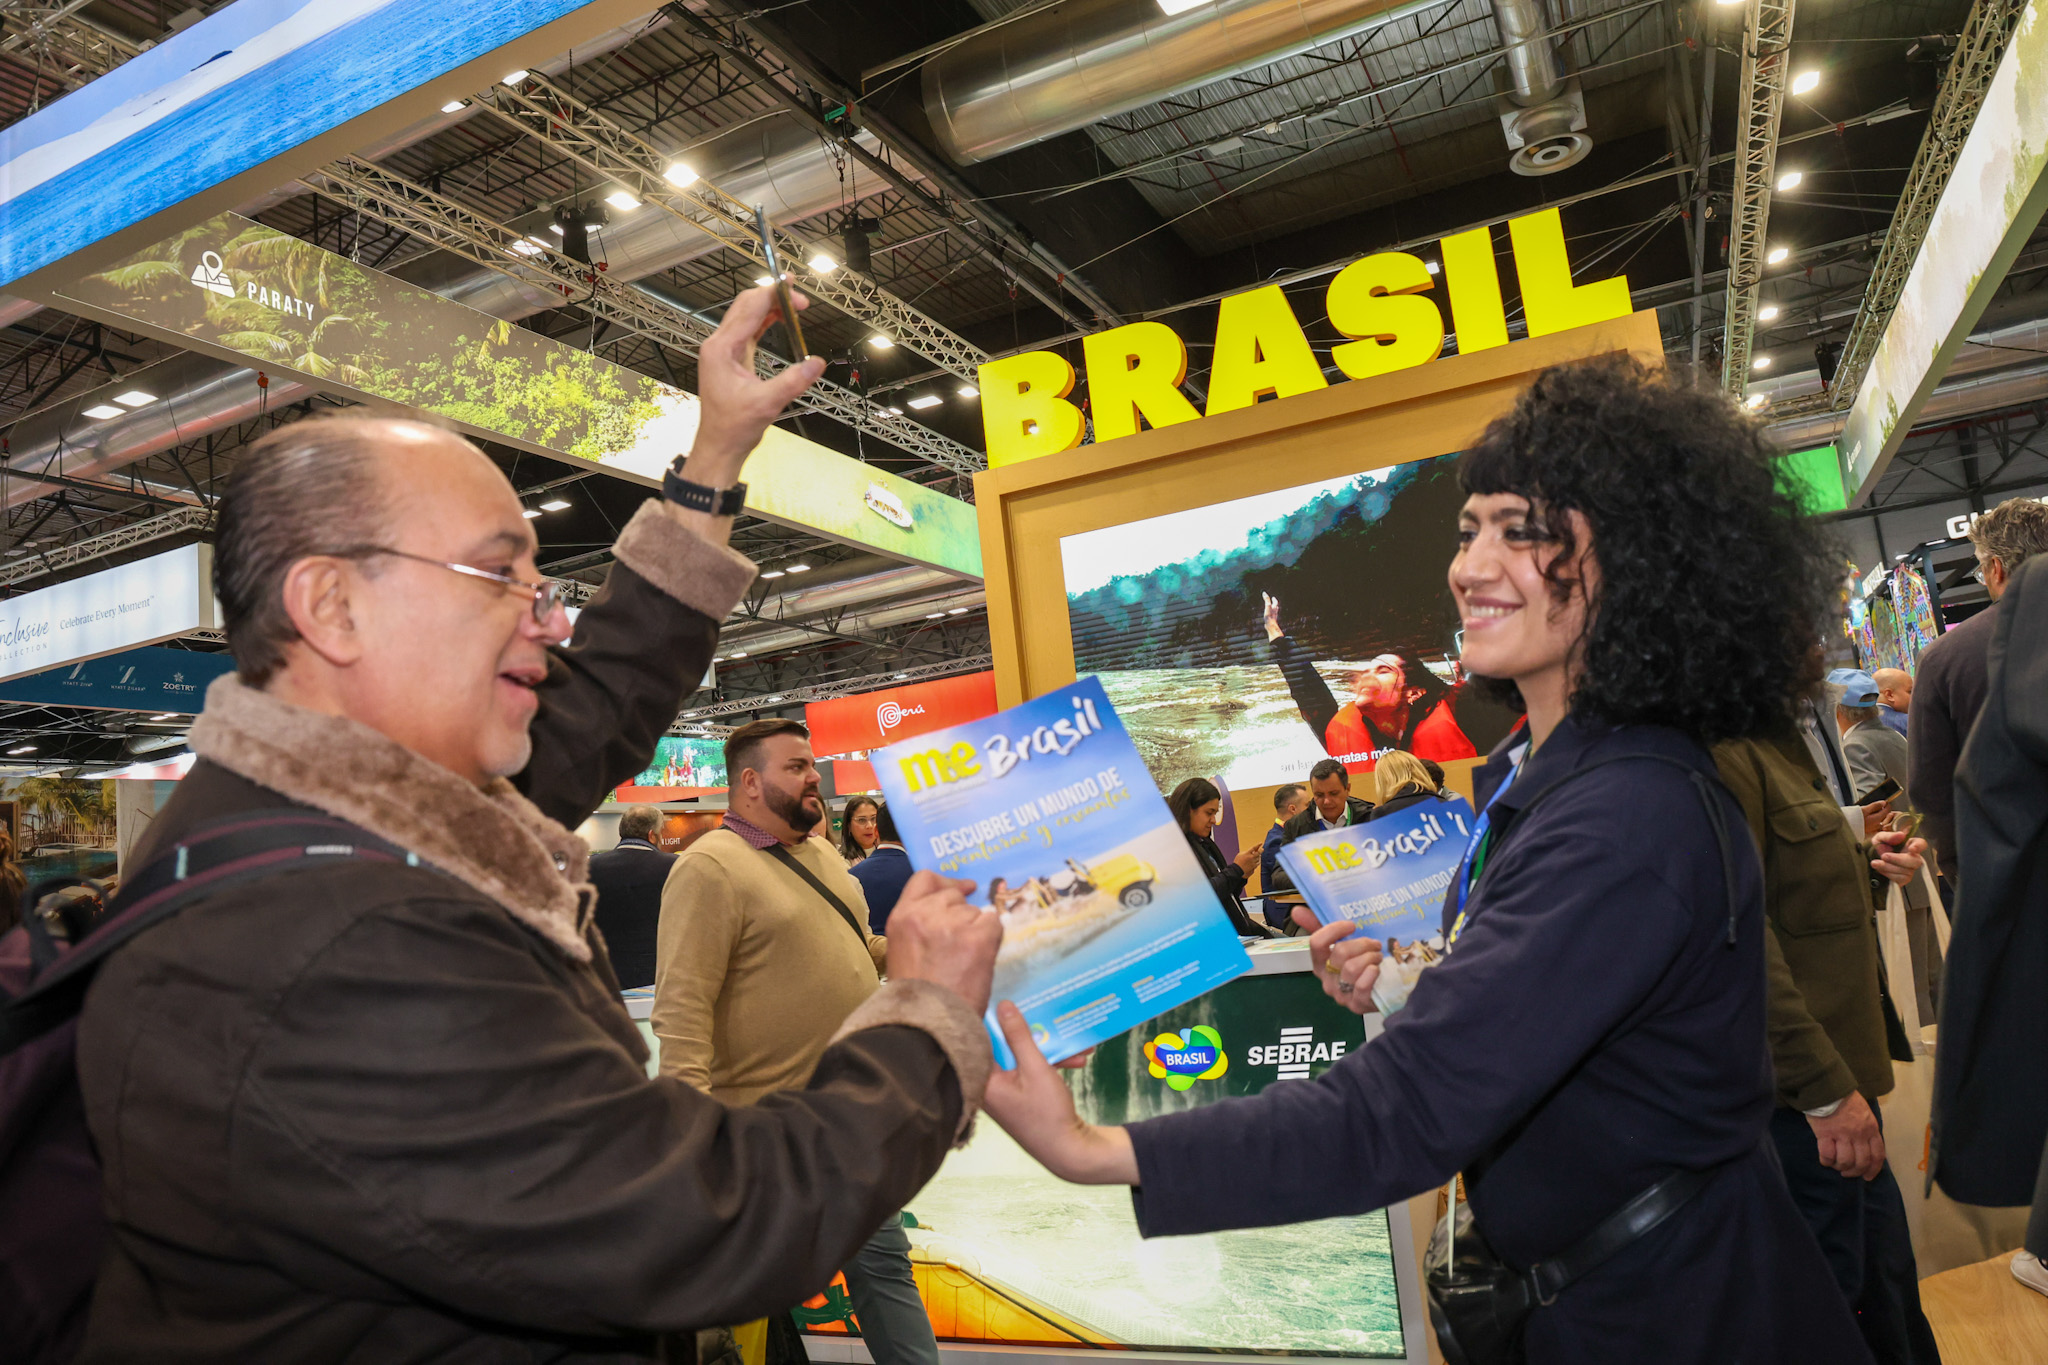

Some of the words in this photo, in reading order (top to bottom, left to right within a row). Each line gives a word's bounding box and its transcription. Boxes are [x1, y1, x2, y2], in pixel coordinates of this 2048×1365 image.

[247, 281, 315, 321] PARATY
[978, 206, 1633, 470] BRASIL
[0, 616, 50, 647] nclusive
[60, 614, 94, 630] Celebrate
[95, 607, 117, 622] Every
[0, 642, 48, 660] LLECTION
[877, 701, 926, 737] Perú
[984, 696, 1103, 778] Brasil
[930, 811, 1016, 859] DESCUBRE
[1013, 801, 1042, 827] UN
[1038, 777, 1100, 817] MUNDO
[1097, 766, 1125, 793] DE
[664, 837, 681, 846] LIGHT
[1361, 812, 1446, 869] Brasil
[1339, 892, 1397, 920] DESCUBRE
[1391, 886, 1413, 905] UN
[1408, 870, 1452, 898] MUNDO
[1165, 1051, 1212, 1067] BRASIL
[1247, 1041, 1347, 1066] SEBRAE
